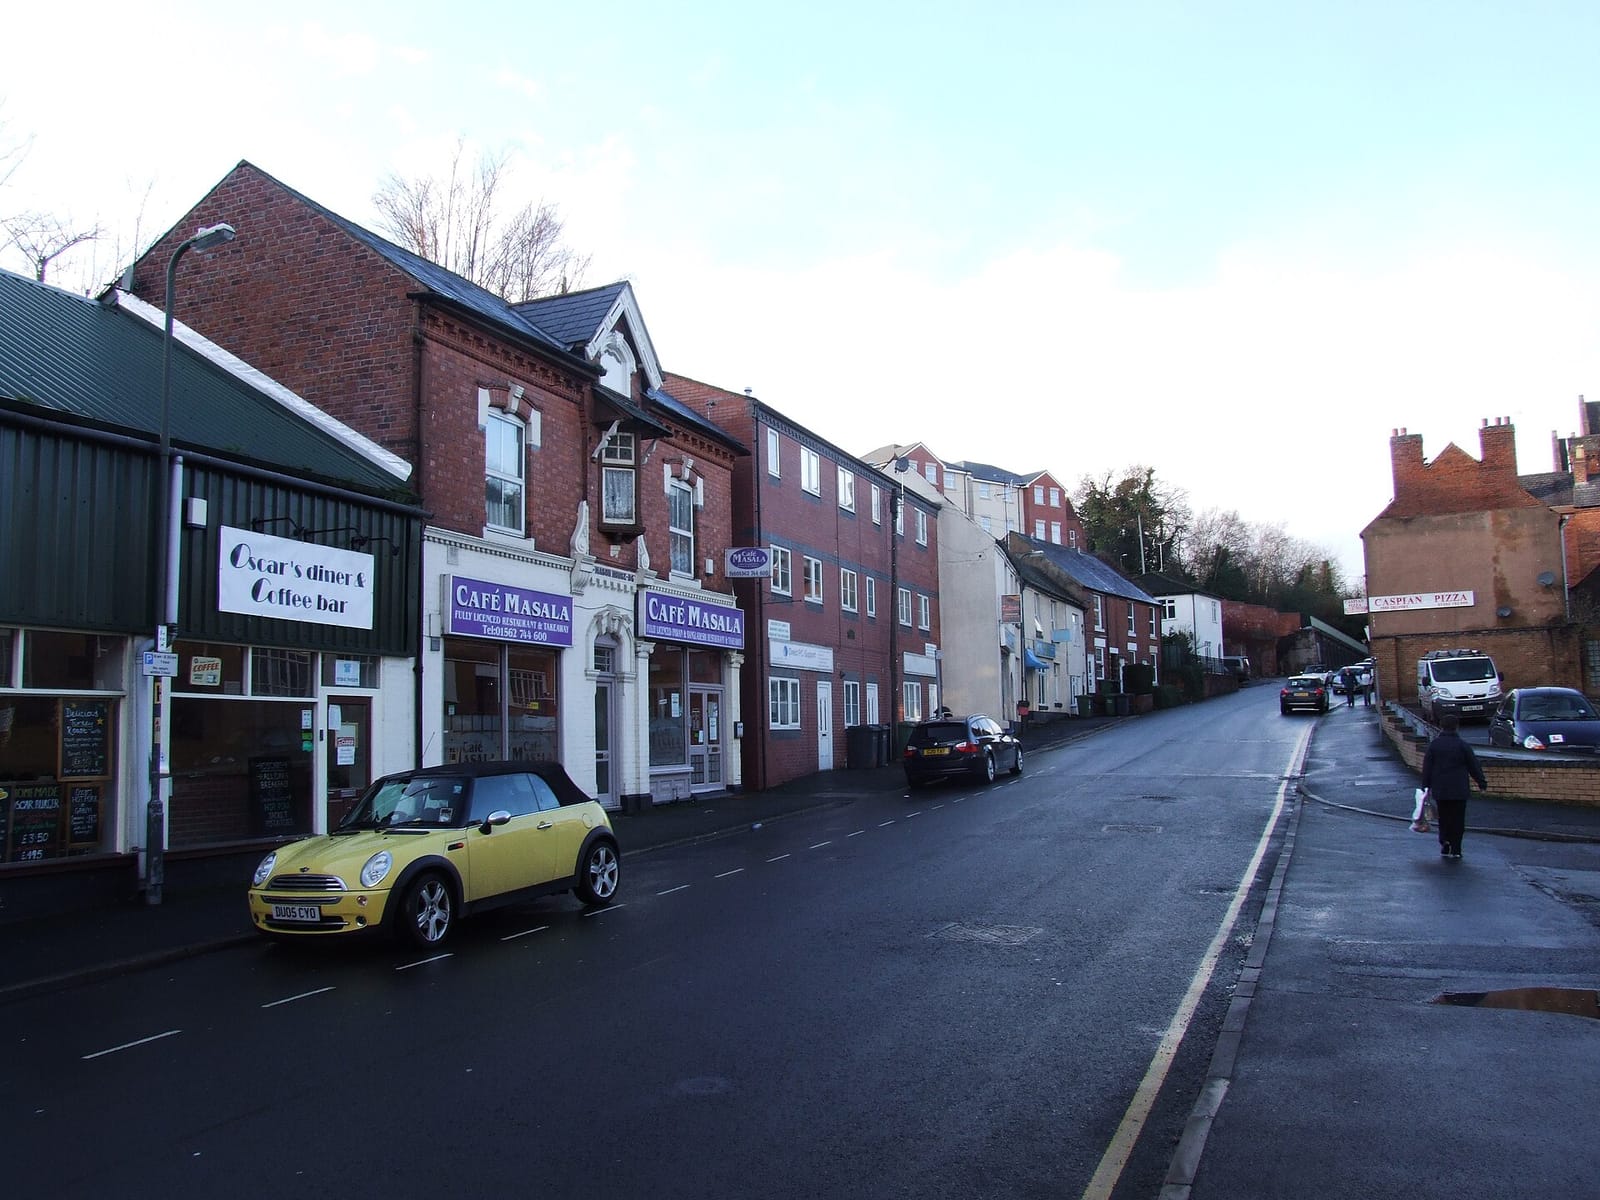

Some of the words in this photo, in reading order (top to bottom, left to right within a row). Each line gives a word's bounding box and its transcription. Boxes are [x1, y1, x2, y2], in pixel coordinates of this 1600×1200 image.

[230, 543, 302, 578] Oscar's
[306, 565, 353, 586] diner
[354, 572, 366, 588] &
[732, 554, 766, 563] MASALA
[251, 577, 313, 609] Coffee
[317, 594, 348, 613] bar
[456, 585, 501, 611] CAFÉ
[504, 593, 570, 621] MASALA
[1374, 596, 1422, 606] CASPIAN
[1434, 594, 1467, 603] PIZZA
[455, 610, 473, 620] FULLY
[473, 613, 500, 624] LICENCED
[502, 616, 538, 629] RESTAURANT
[543, 621, 569, 634] TAKEAWAY
[649, 597, 685, 625] CAFÉ
[688, 605, 742, 633] MASALA
[519, 629, 532, 639] 744
[533, 632, 547, 641] 600
[193, 663, 219, 673] COFFEE
[64, 707, 99, 718] Delicious
